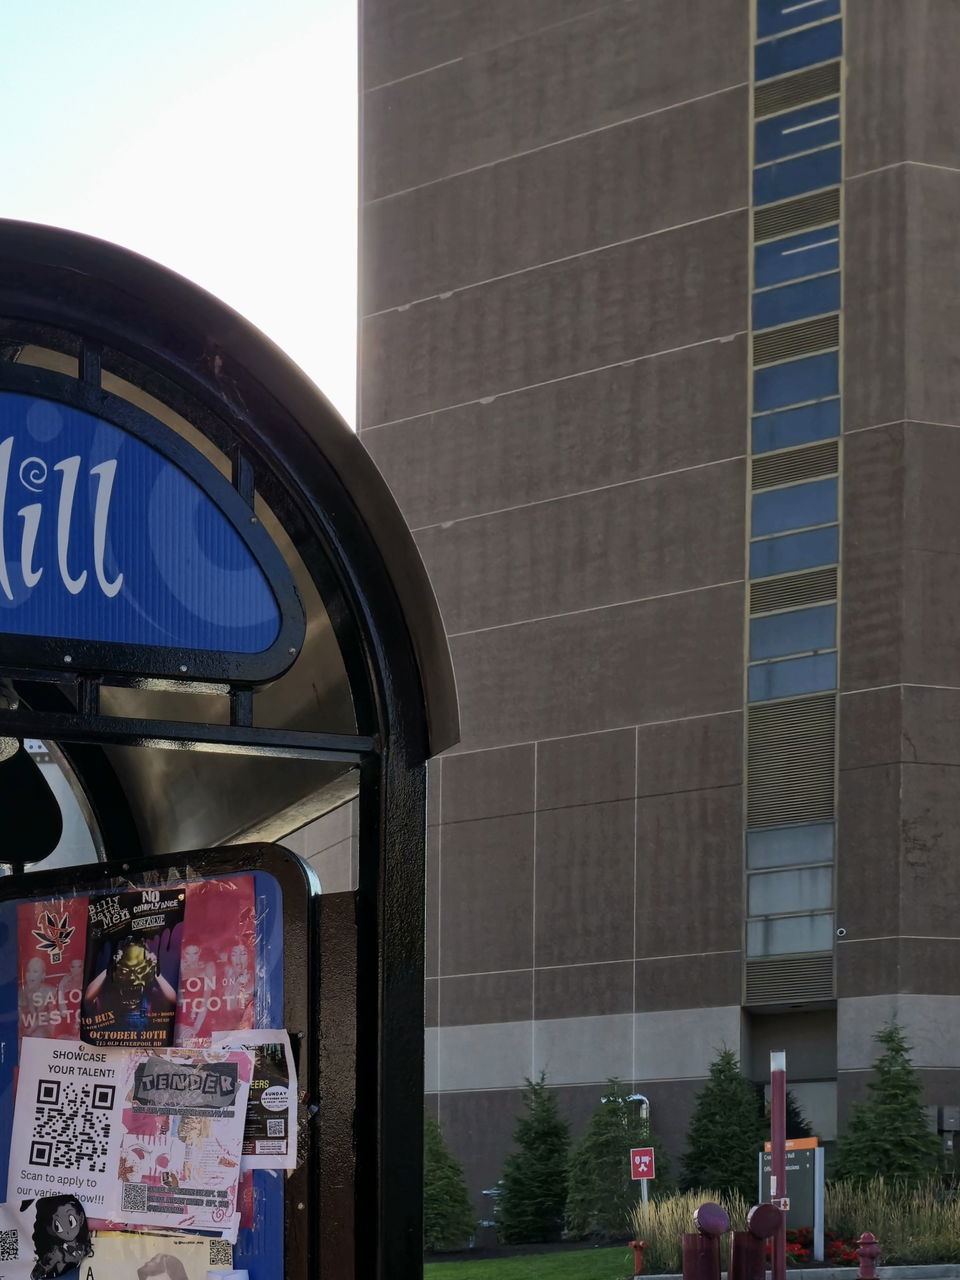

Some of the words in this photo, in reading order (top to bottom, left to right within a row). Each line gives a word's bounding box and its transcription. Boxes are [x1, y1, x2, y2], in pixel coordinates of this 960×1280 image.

[142, 891, 160, 902] NO
[88, 896, 120, 914] Billy
[133, 900, 179, 913] COMPLYANCE
[95, 1010, 115, 1023] BUX
[89, 1031, 137, 1040] OCTOBER
[141, 1030, 167, 1039] 30TH
[52, 1051, 106, 1063] SHOWCASE
[48, 1064, 75, 1075] YOUR
[78, 1067, 115, 1078] TALENT!
[142, 1073, 235, 1096] TENDER
[21, 1170, 43, 1181] Scan
[45, 1172, 55, 1183] to
[57, 1175, 84, 1188] apply
[87, 1178, 97, 1188] to
[17, 1187, 33, 1196] our
